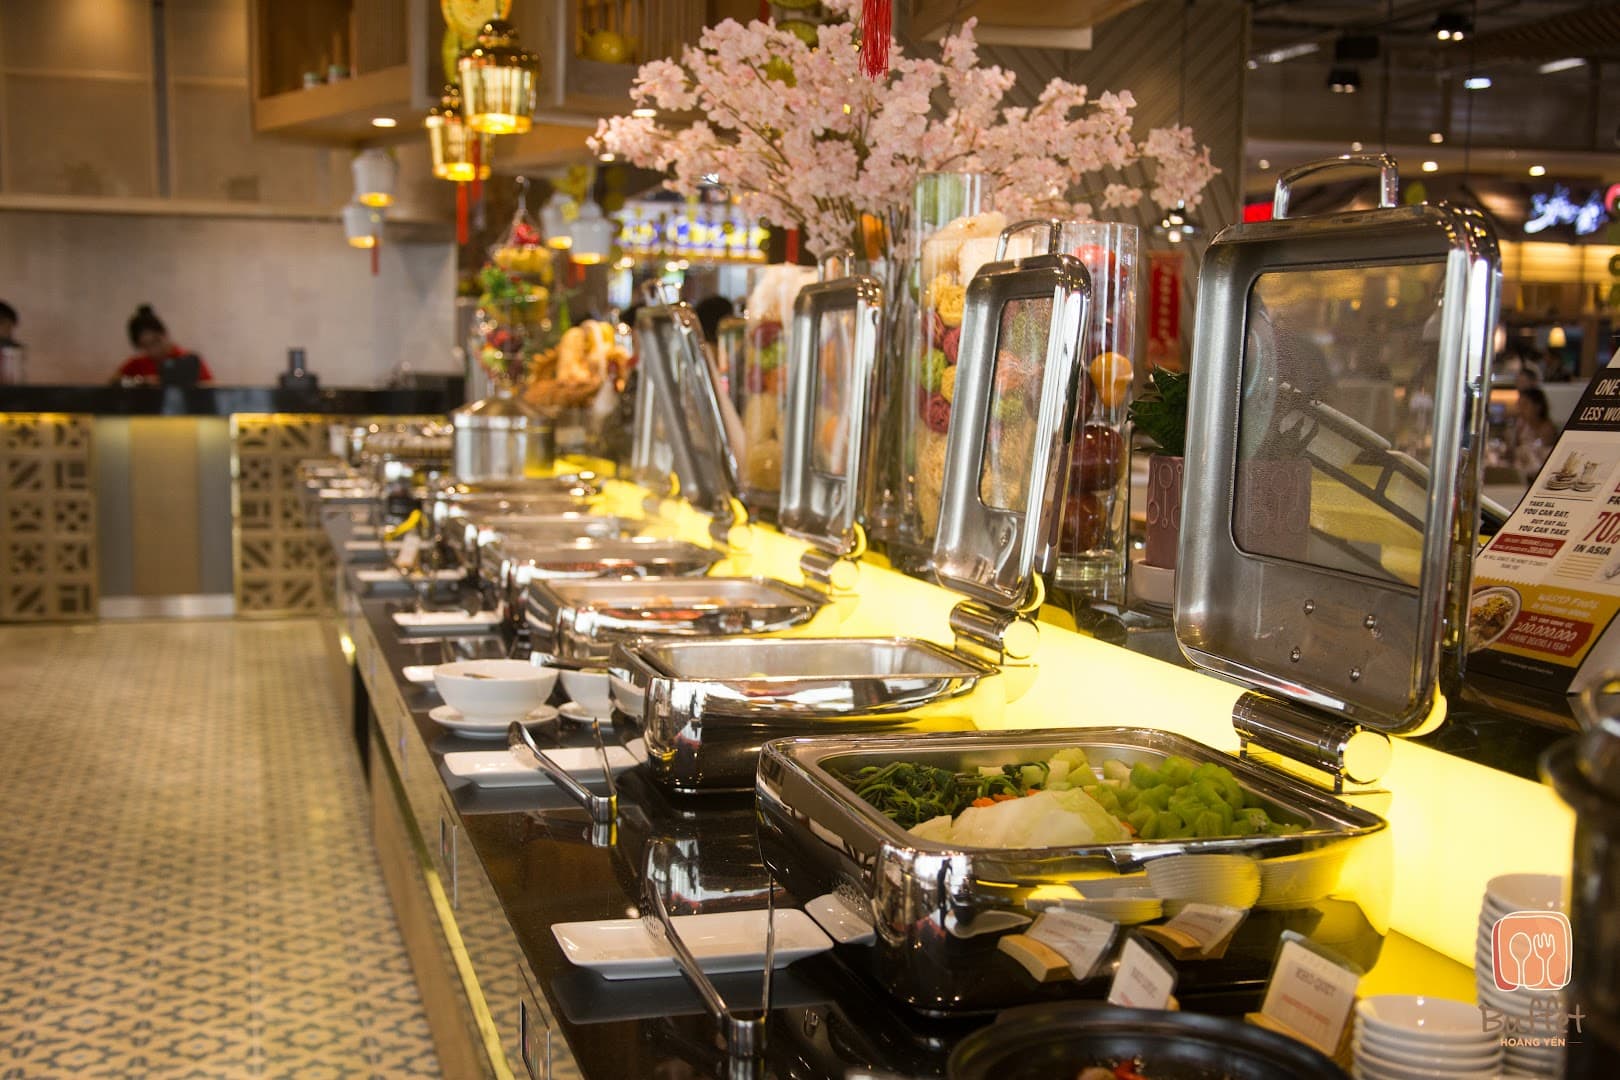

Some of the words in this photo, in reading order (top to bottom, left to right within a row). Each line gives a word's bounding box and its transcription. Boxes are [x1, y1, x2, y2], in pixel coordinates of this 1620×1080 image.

[1594, 378, 1620, 396] ONE
[1580, 406, 1605, 421] LESS
[1518, 524, 1534, 532] YOU
[1550, 528, 1570, 536] TAKE
[1572, 543, 1587, 553] IN
[1586, 545, 1612, 556] ASIA
